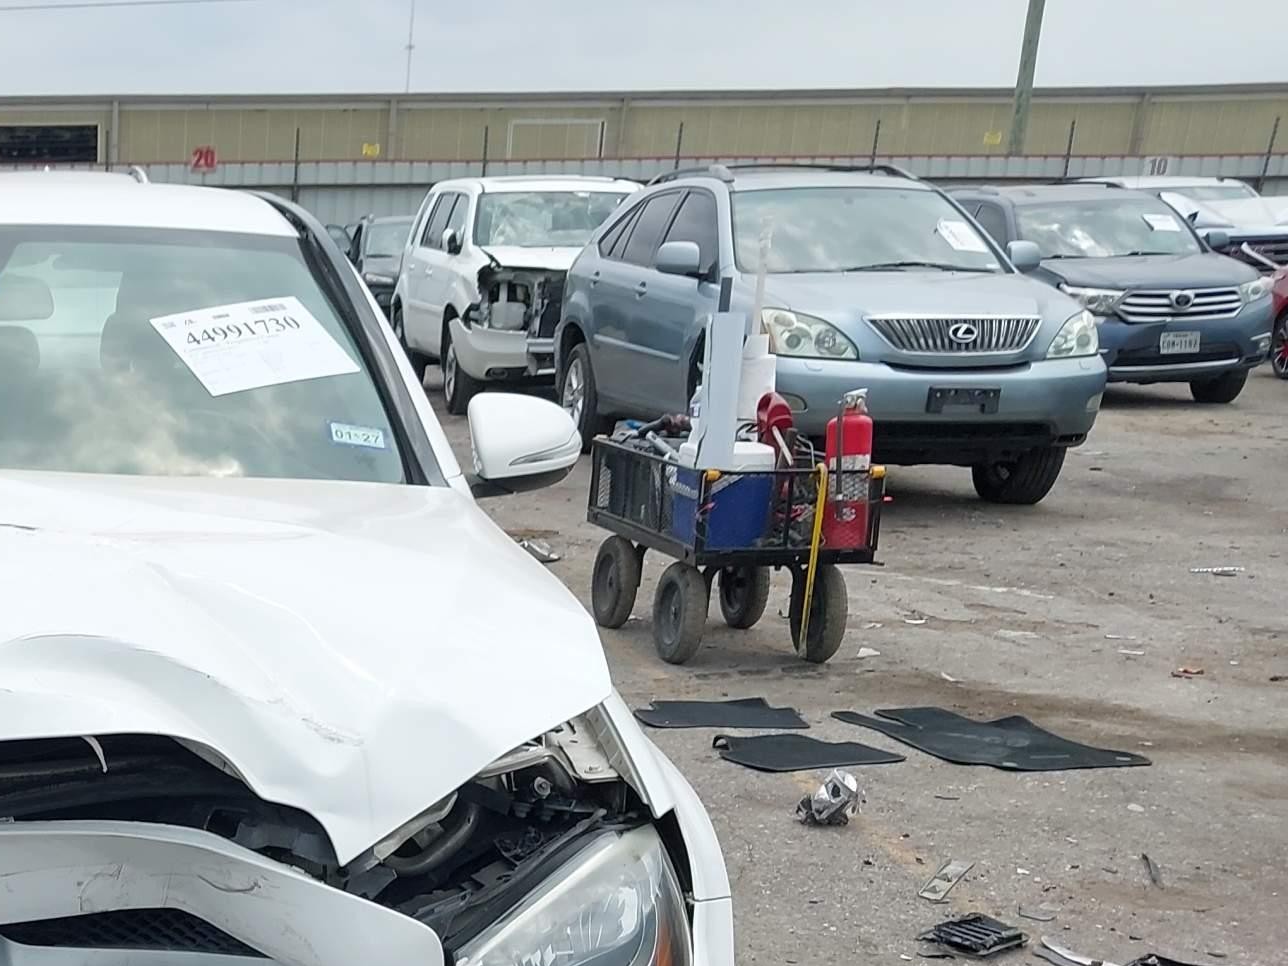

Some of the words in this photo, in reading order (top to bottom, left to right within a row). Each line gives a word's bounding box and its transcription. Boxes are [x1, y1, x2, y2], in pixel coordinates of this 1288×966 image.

[192, 148, 216, 168] 20
[1150, 159, 1168, 176] 10
[187, 315, 300, 345] 44991730
